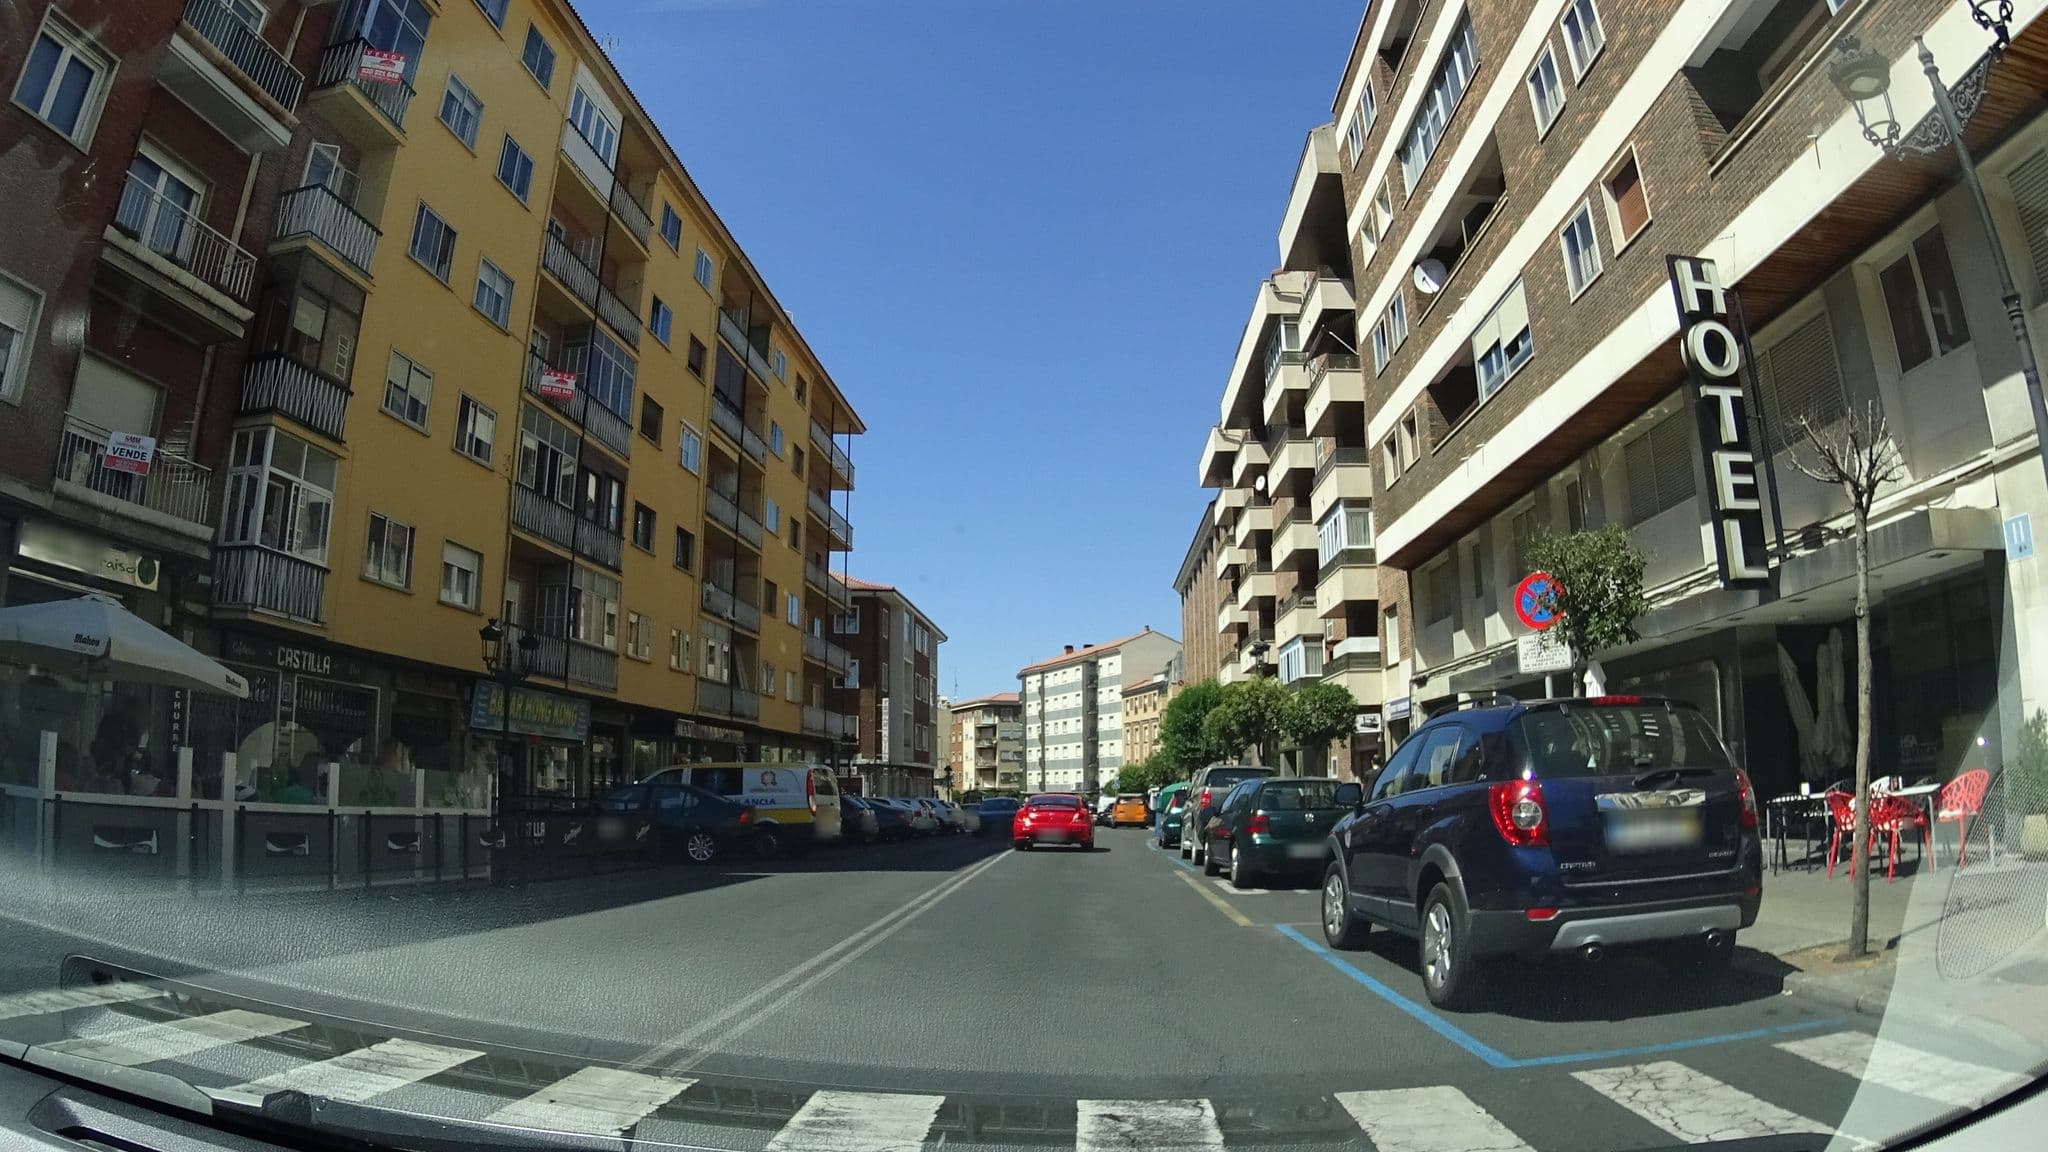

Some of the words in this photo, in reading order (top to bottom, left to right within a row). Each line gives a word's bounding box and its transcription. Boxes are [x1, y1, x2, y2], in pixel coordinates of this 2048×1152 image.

[1673, 257, 1769, 581] HOTEL
[112, 446, 148, 461] VENDE
[276, 645, 332, 675] CASTILLA
